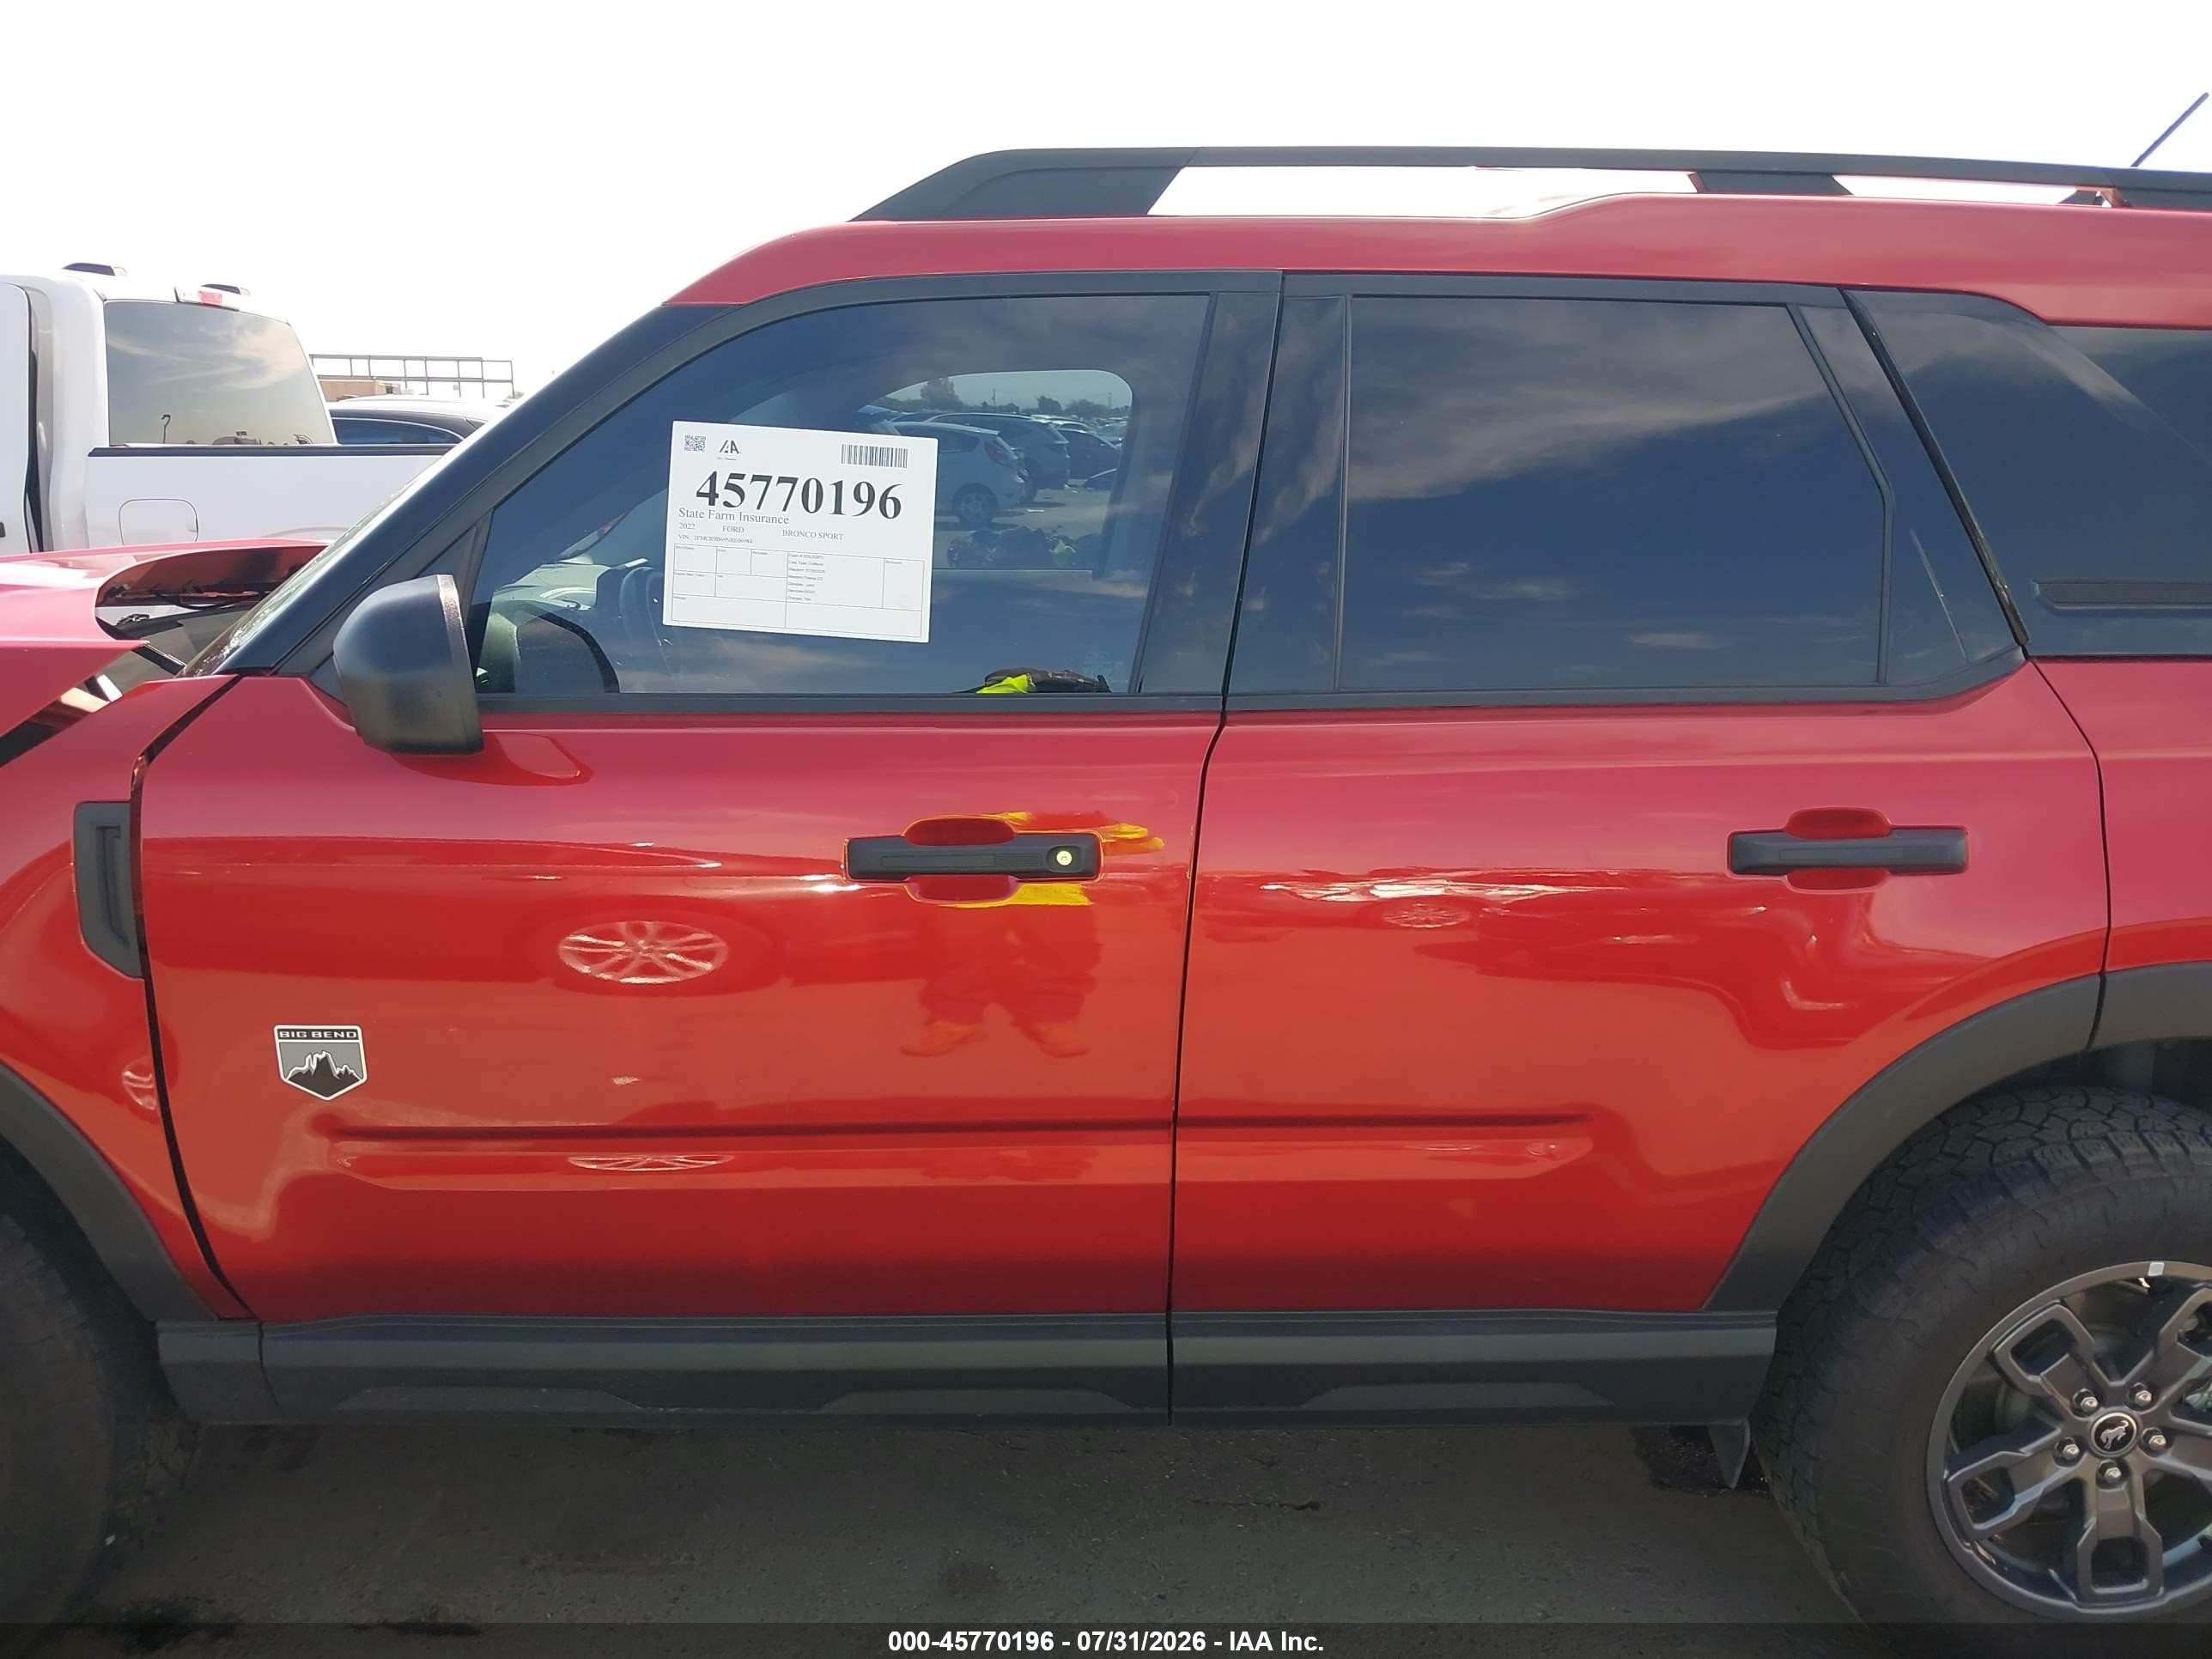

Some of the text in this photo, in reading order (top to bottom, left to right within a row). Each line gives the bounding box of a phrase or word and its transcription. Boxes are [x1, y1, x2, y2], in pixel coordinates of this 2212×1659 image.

[696, 471, 904, 520] 45770196
[678, 507, 790, 525] State Farm Insurance
[722, 525, 745, 533] FORD
[782, 529, 817, 538] BRONCO
[817, 532, 844, 540] SPORT
